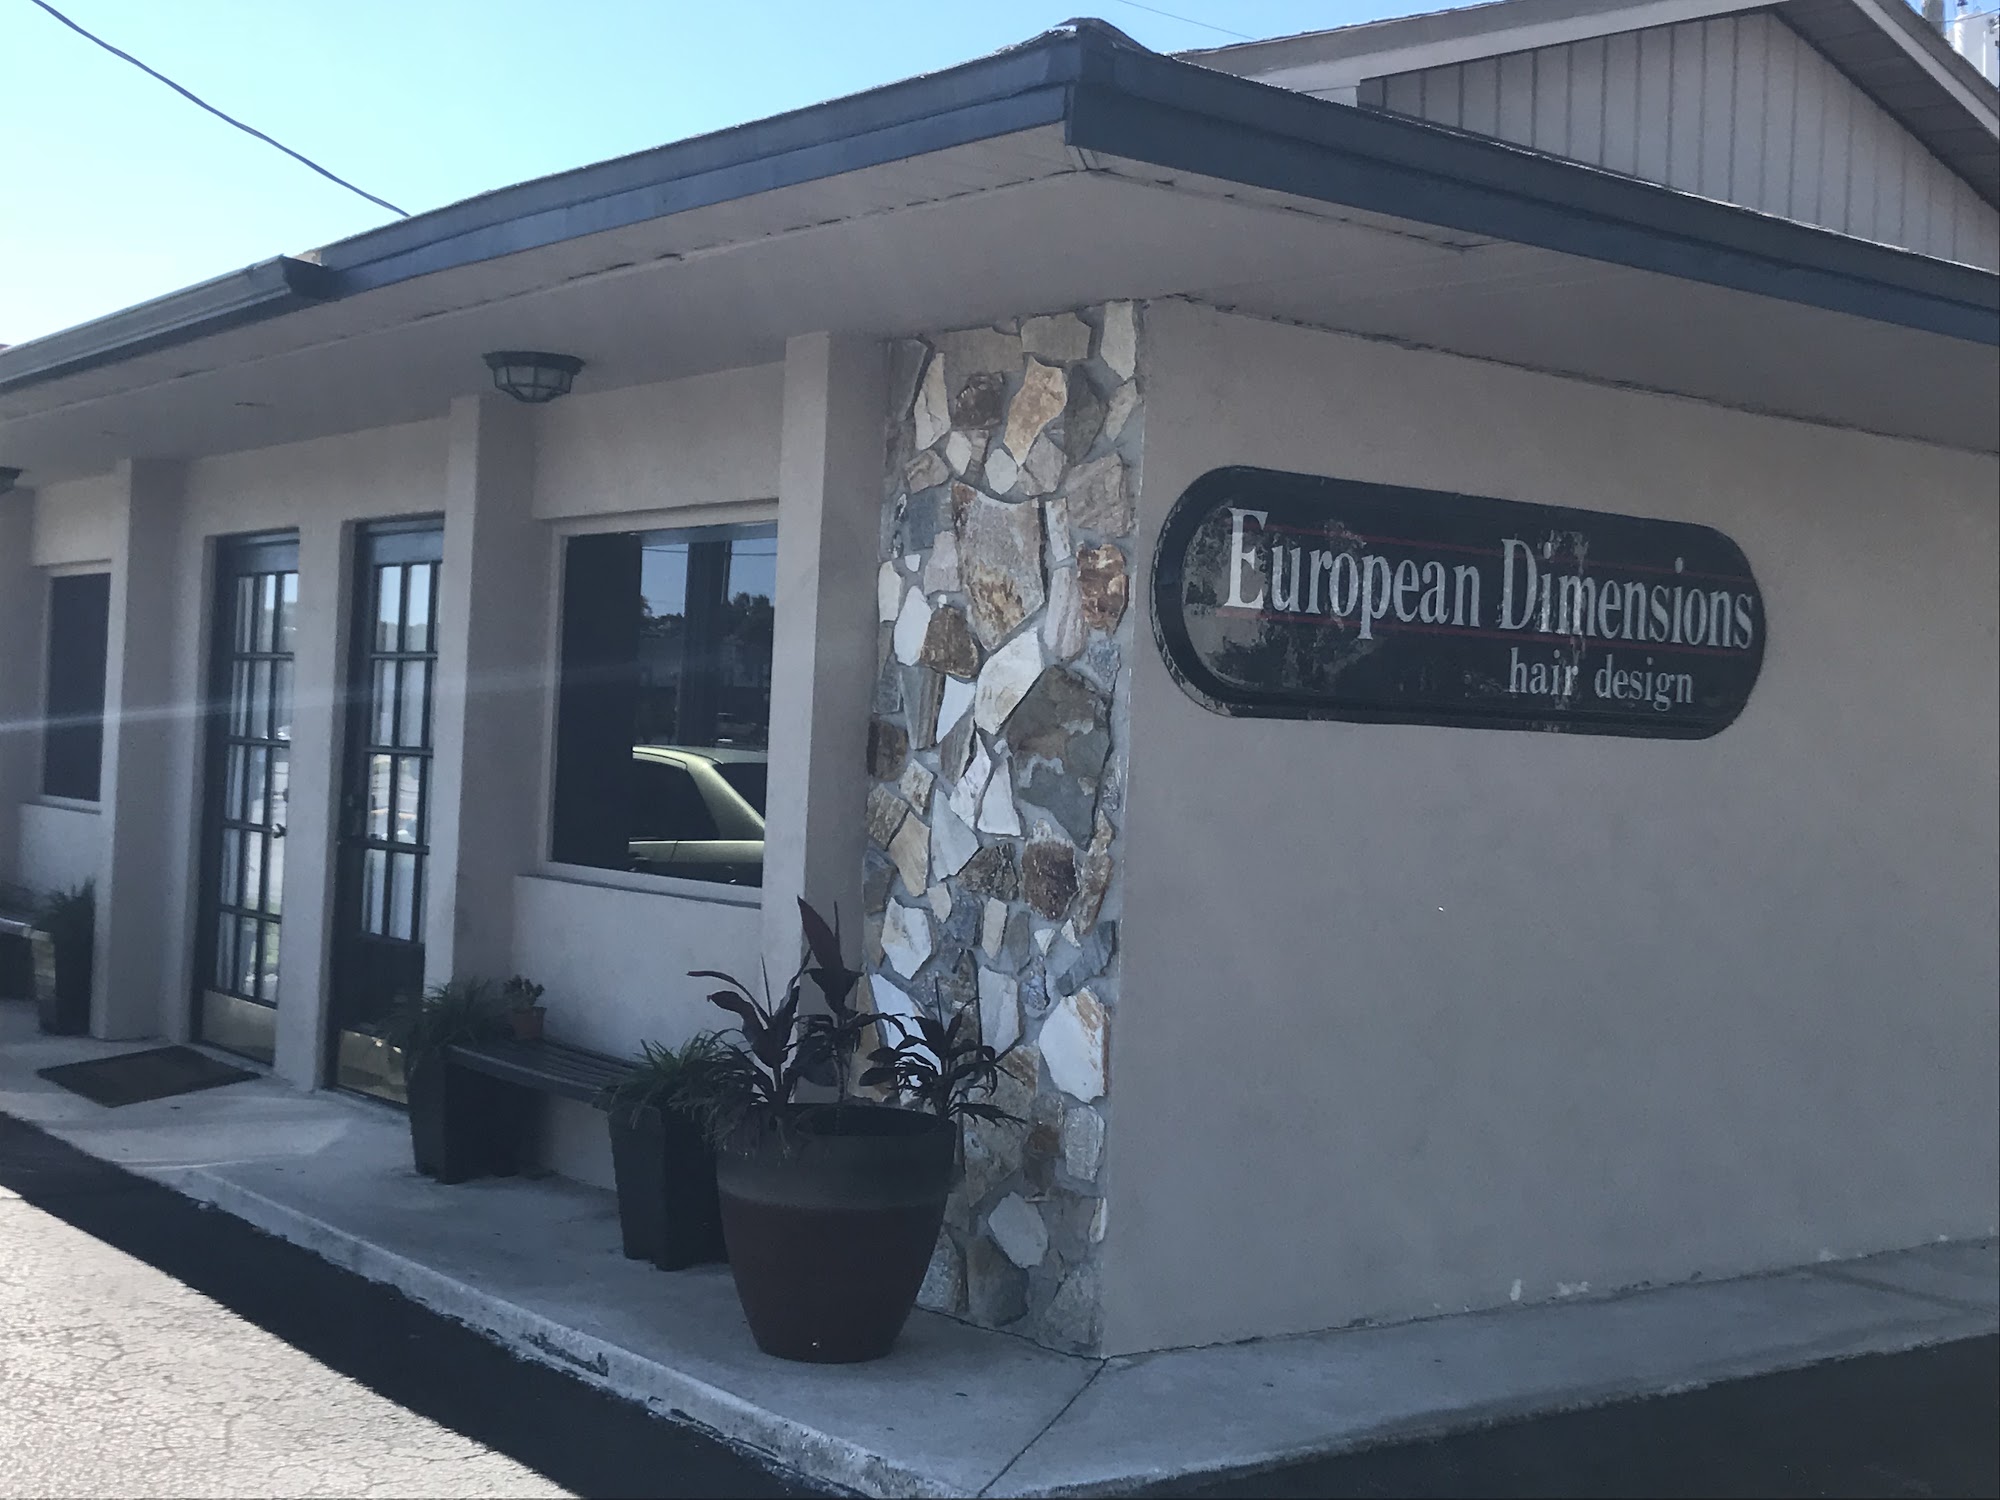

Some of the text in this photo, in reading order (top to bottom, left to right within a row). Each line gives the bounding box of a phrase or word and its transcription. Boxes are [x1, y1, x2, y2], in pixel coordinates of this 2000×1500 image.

[1224, 508, 1754, 649] European Dimensions
[1509, 647, 1693, 711] hair design
